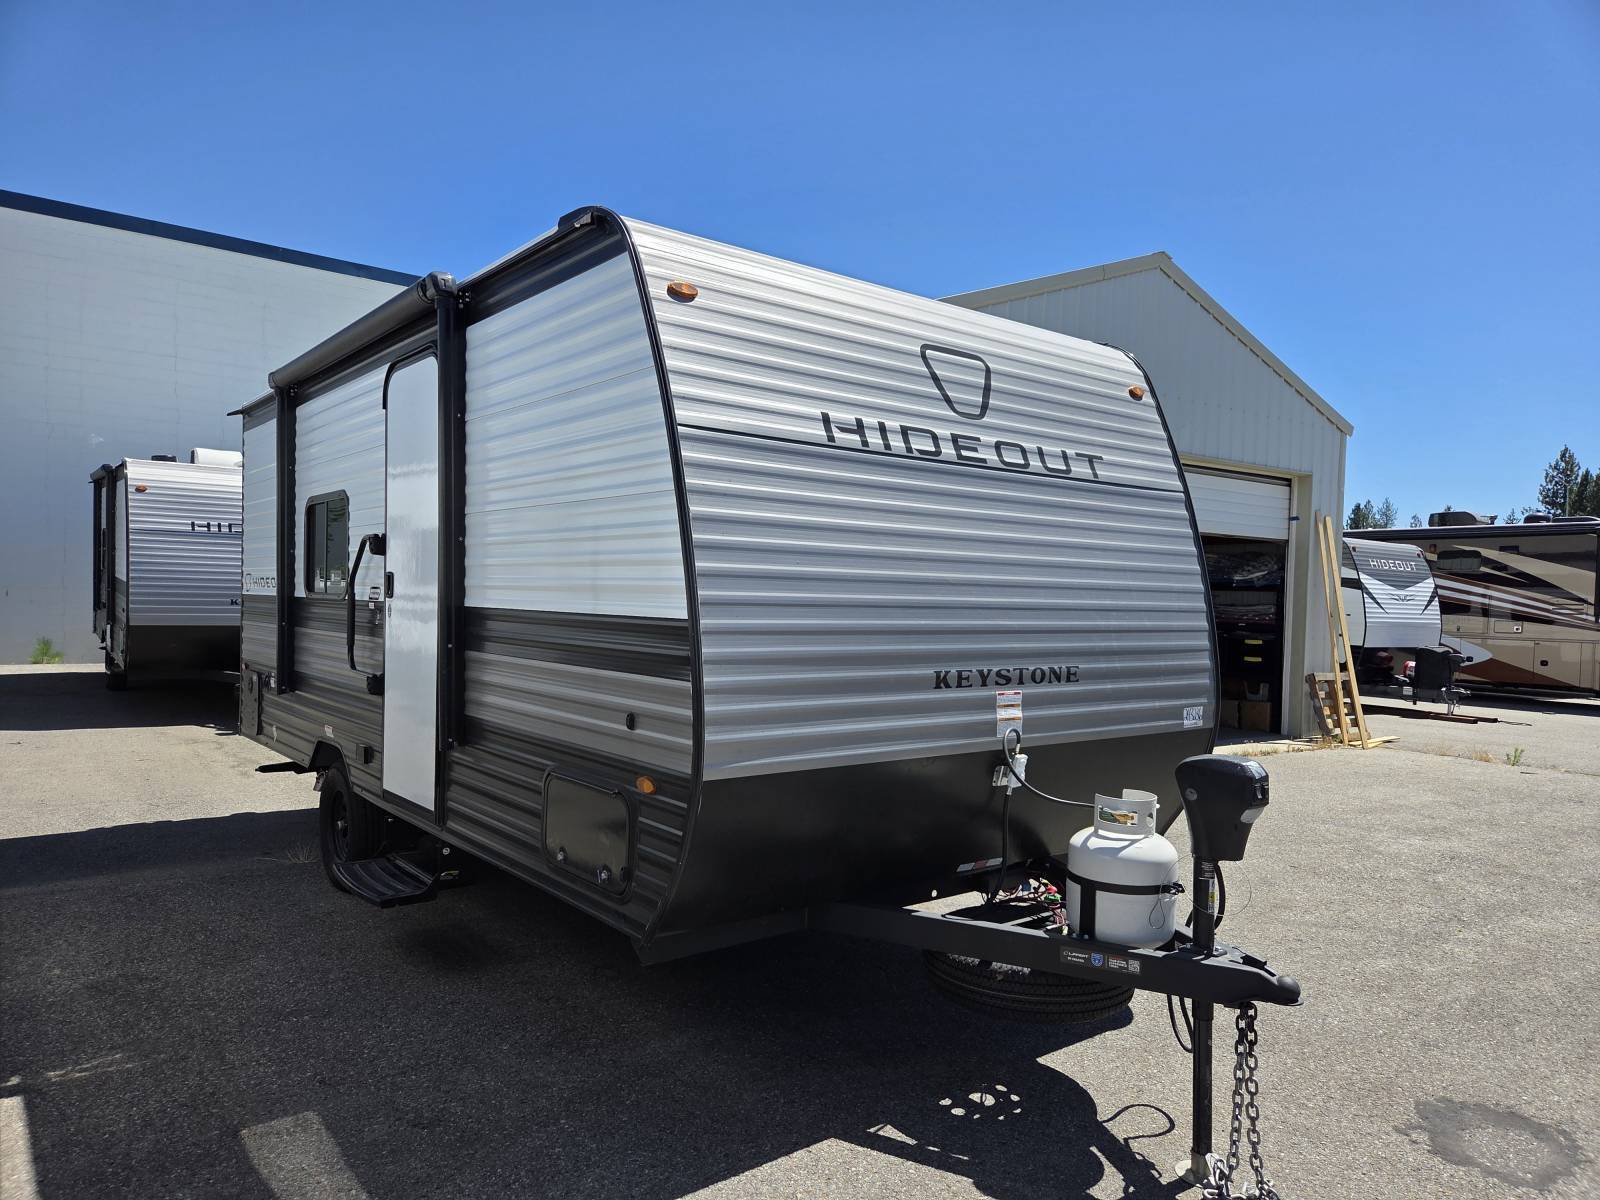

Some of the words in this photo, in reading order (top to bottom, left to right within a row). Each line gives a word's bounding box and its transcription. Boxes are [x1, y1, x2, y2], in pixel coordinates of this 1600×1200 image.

[820, 411, 1104, 480] HIDEOUT
[1369, 559, 1416, 571] HIDEOUT
[933, 665, 1080, 690] KEYSTONE
